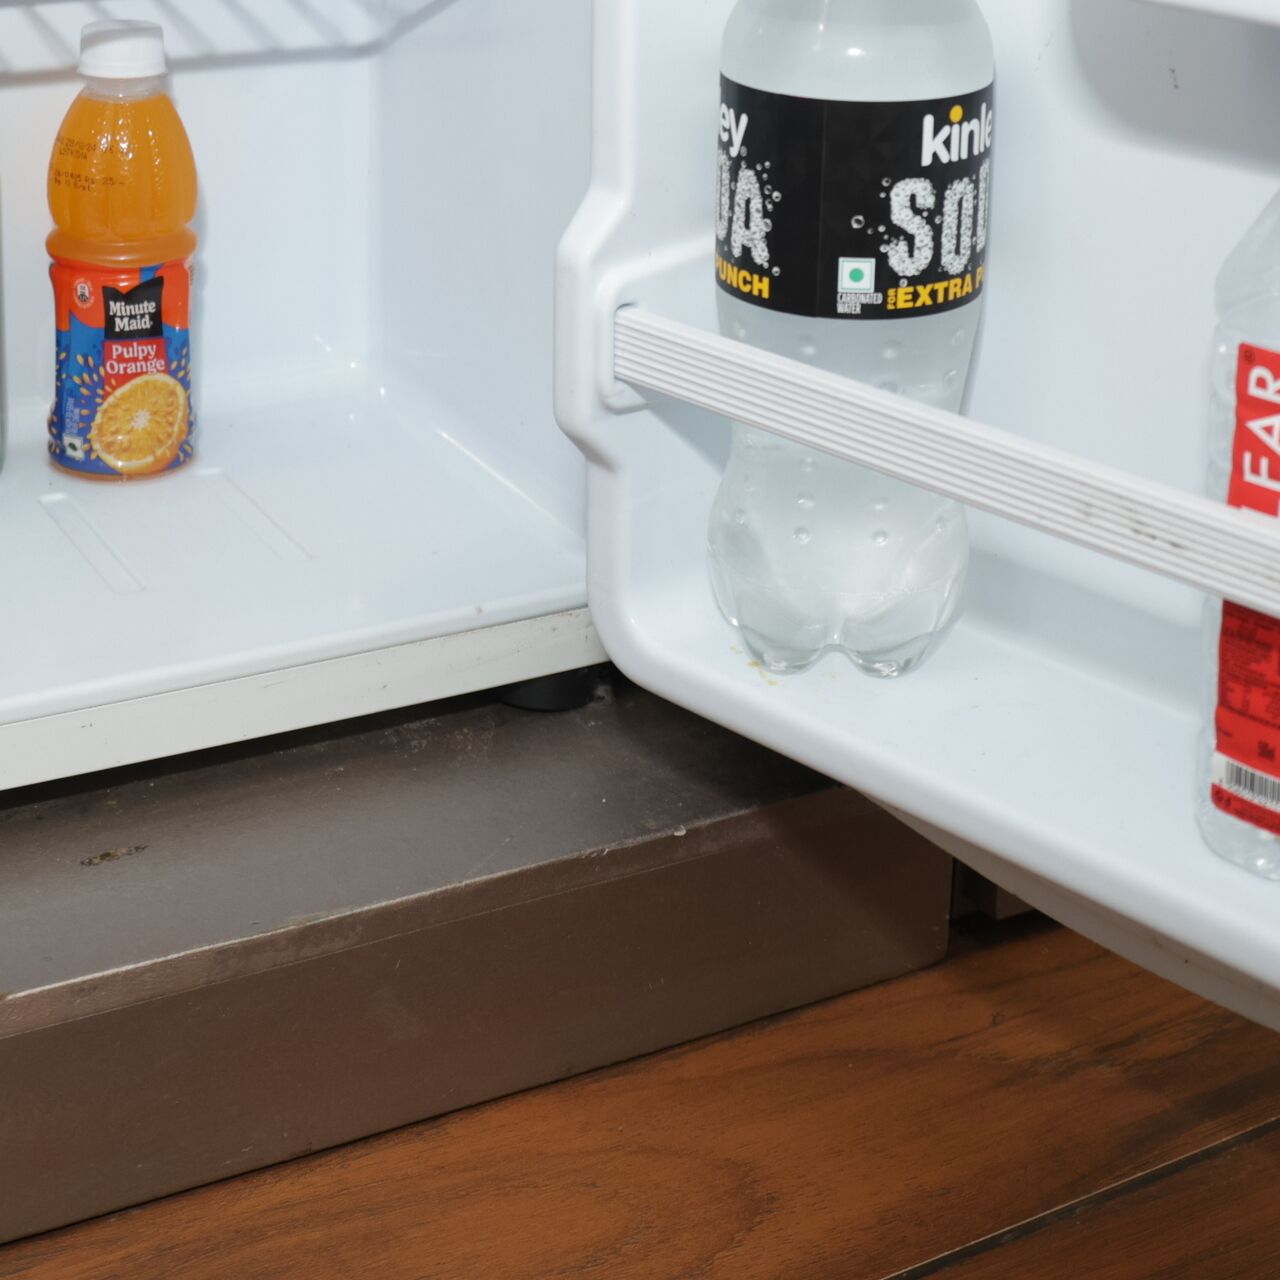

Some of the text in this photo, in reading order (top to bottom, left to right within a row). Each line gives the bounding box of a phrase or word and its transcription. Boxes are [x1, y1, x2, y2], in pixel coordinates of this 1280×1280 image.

[921, 101, 993, 167] kinle
[836, 292, 883, 305] CARBONATED
[886, 288, 898, 310] FOR
[897, 273, 973, 309] EXTRA
[109, 300, 156, 317] Minute
[836, 303, 862, 315] WATER
[114, 315, 150, 332] Maid
[111, 343, 157, 361] Pulpy
[105, 358, 166, 375] Orange
